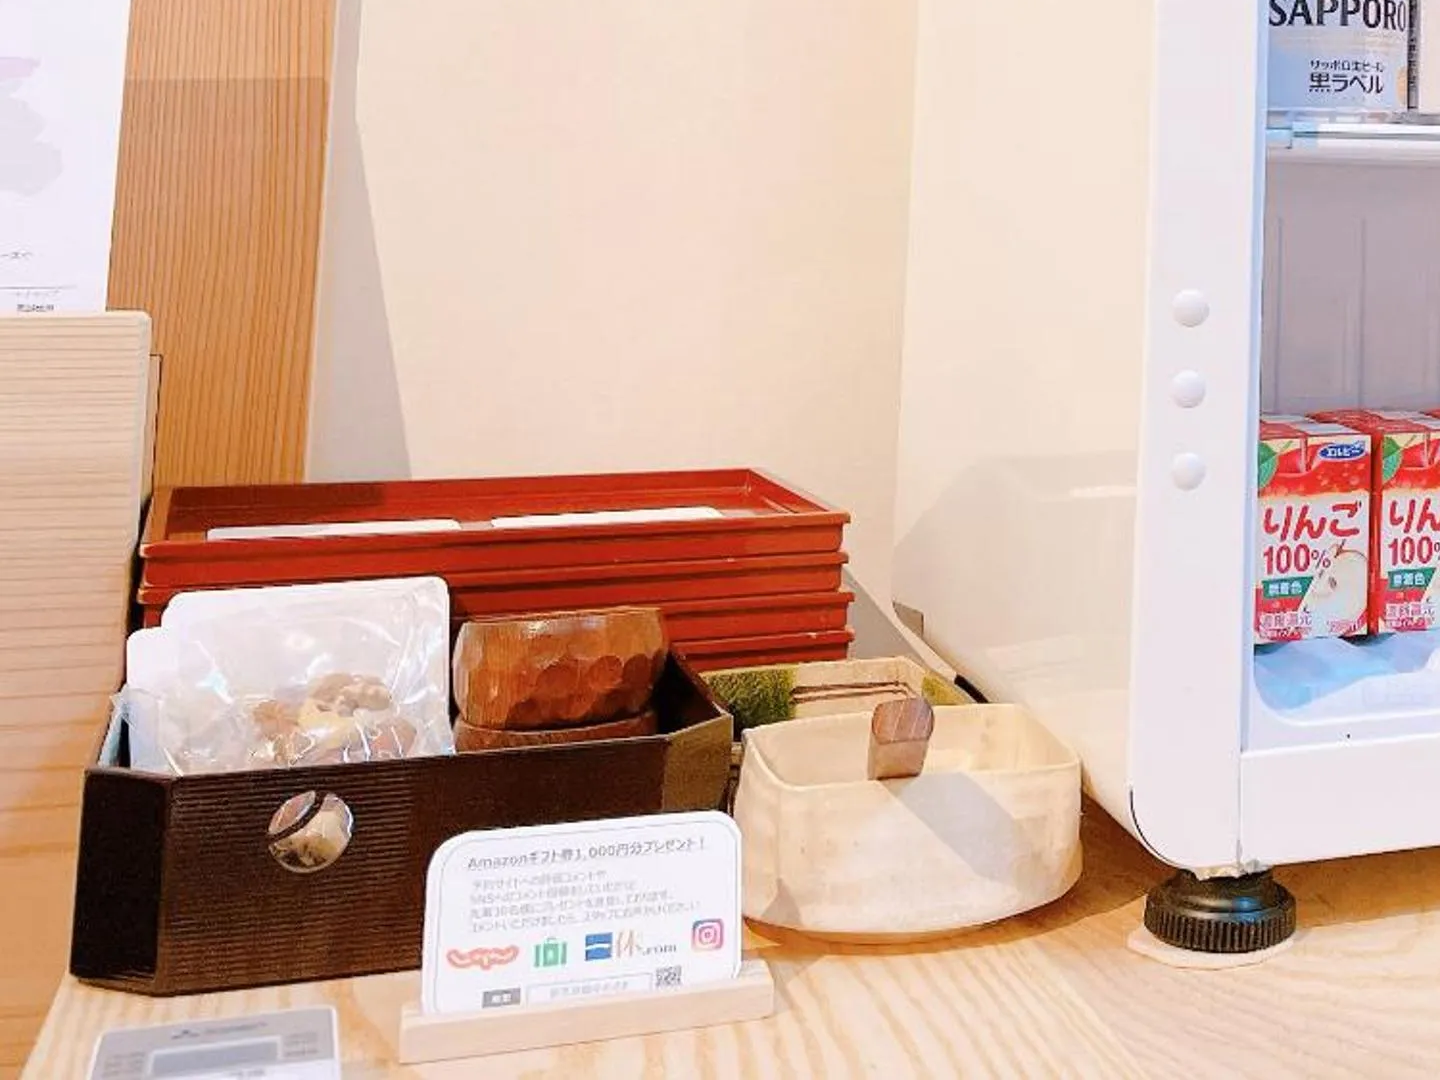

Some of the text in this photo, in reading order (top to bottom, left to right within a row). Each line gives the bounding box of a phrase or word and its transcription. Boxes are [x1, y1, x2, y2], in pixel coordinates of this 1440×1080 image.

[1309, 73, 1384, 94] 黒ラベル
[1263, 501, 1362, 541] りんご
[1263, 543, 1331, 575] 100%
